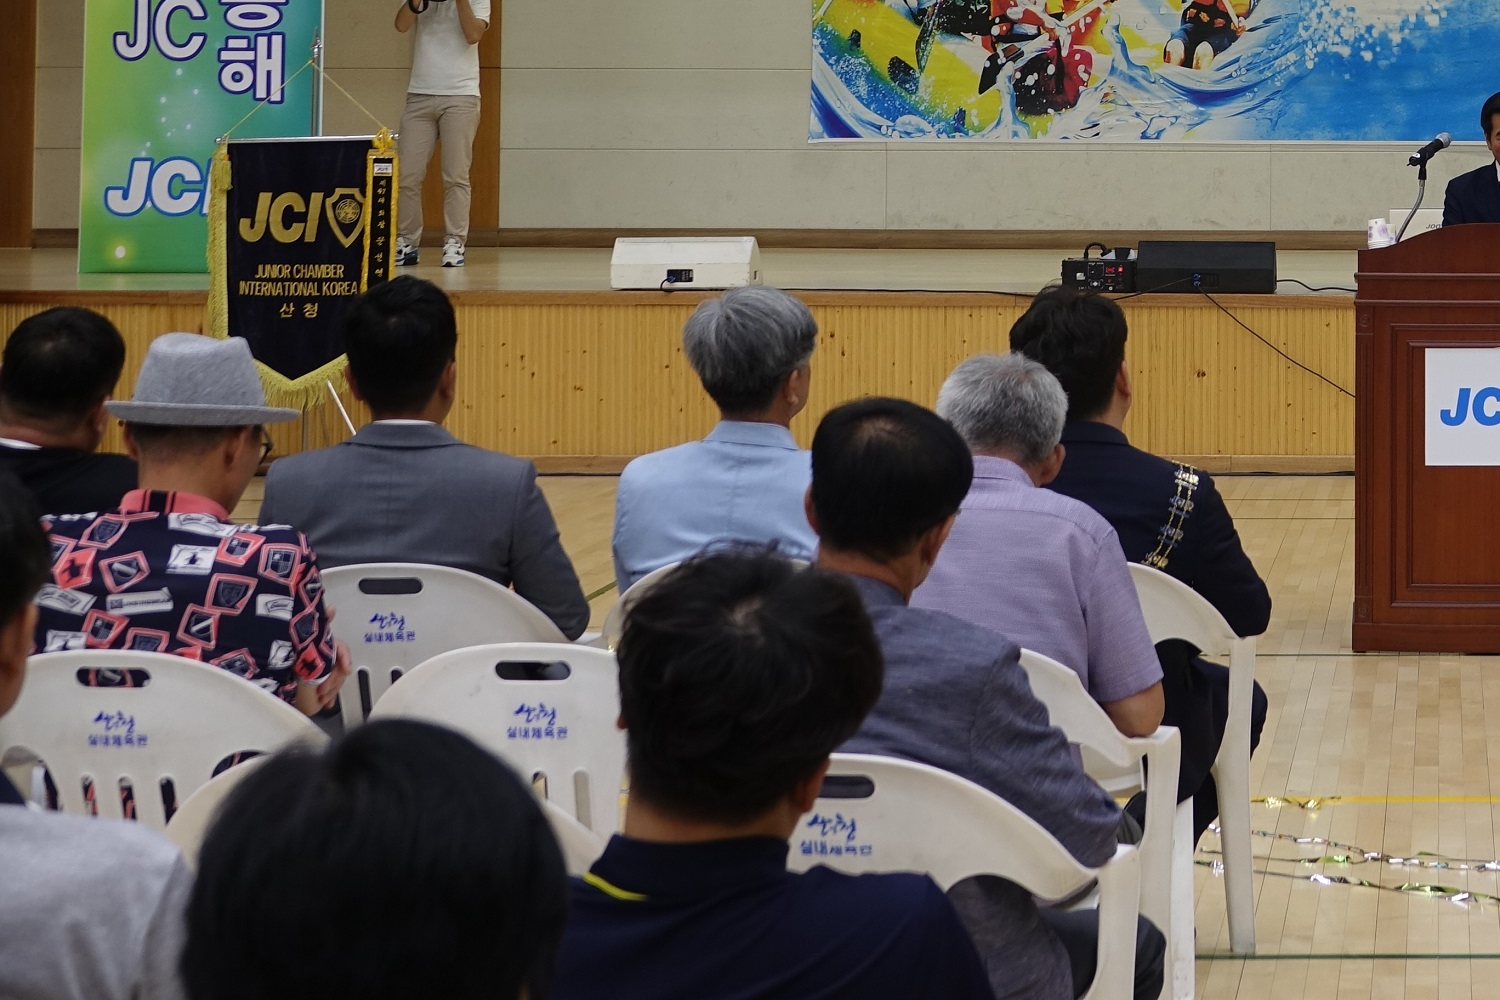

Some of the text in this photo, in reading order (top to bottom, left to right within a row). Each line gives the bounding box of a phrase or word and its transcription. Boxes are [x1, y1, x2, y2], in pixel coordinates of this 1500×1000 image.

[239, 191, 325, 244] JCI
[254, 263, 345, 279] JUNIOR CHAMBER
[239, 281, 358, 297] INTERNATIONAL KOREA
[506, 726, 568, 740] 실내체육관
